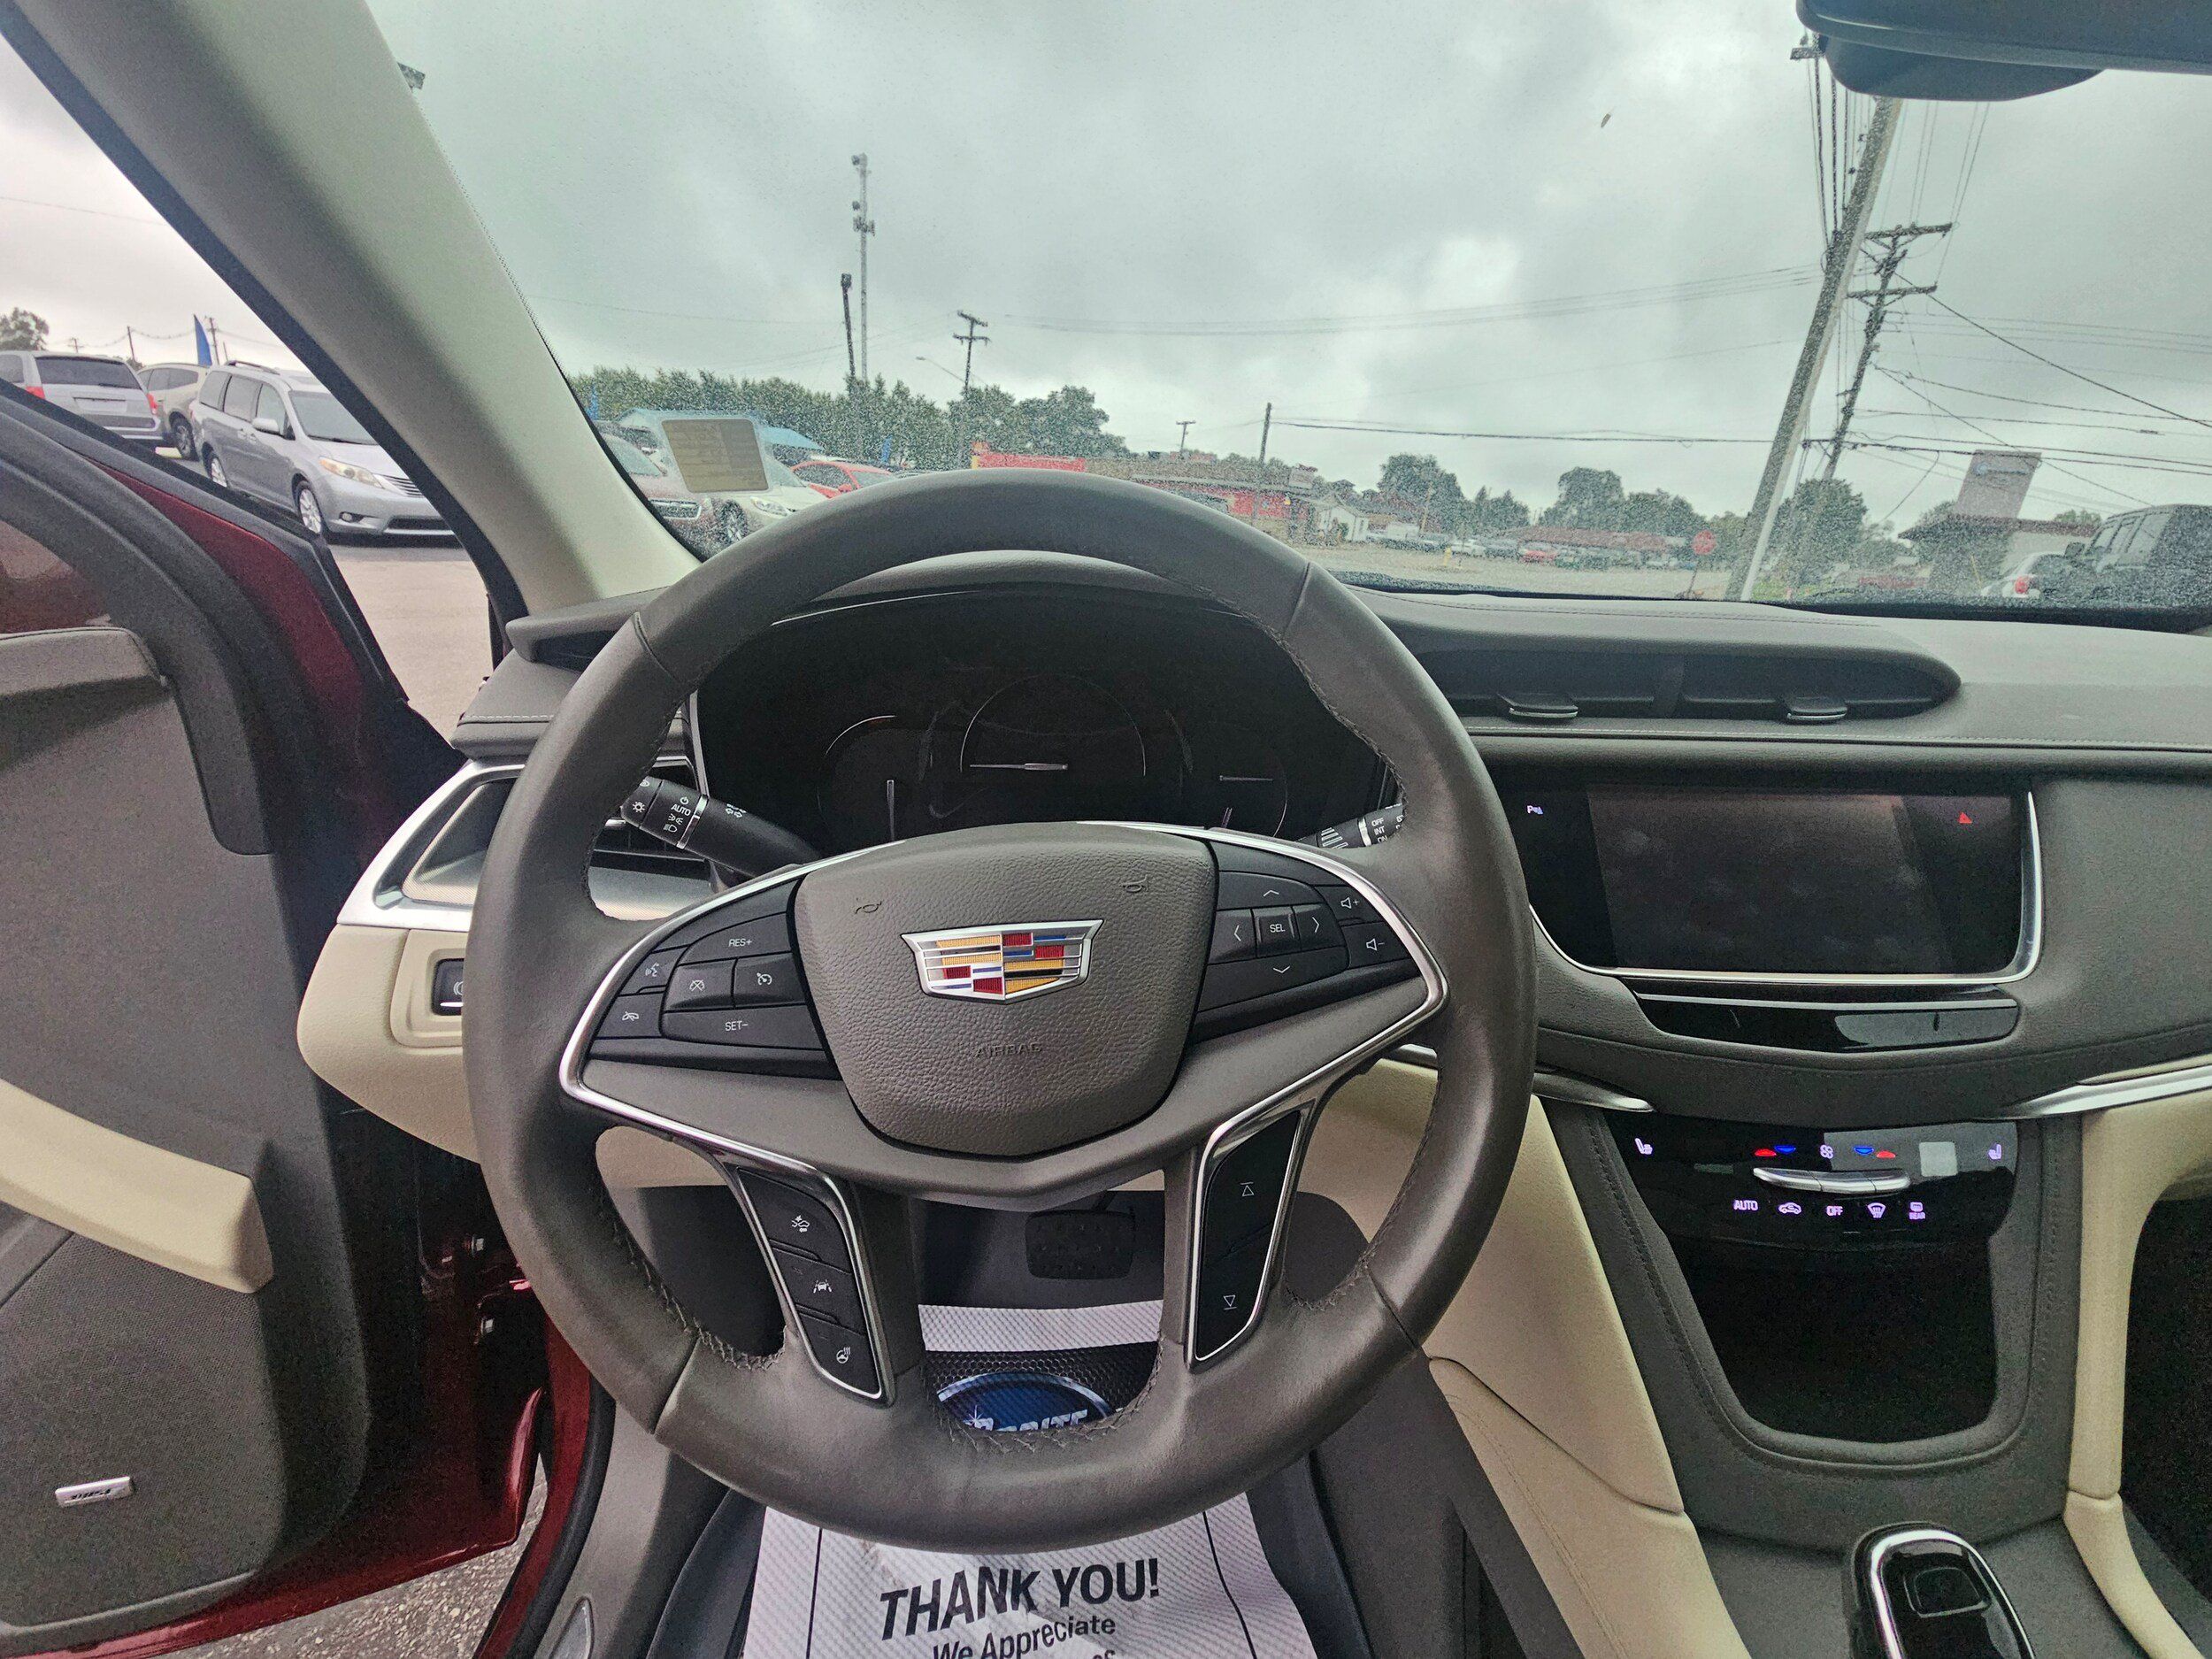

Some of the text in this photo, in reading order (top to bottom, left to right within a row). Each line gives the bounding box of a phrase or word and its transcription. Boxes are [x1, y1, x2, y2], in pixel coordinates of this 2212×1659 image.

[671, 803, 692, 817] AUTO
[1371, 818, 1385, 827] OFF
[1373, 826, 1386, 836] INT
[1269, 923, 1286, 933] SEL
[728, 938, 753, 948] RES+
[725, 1020, 749, 1032] SET-
[974, 1042, 1043, 1058] AIRBAG
[1733, 1199, 1759, 1211] AUTO
[1825, 1205, 1844, 1217] OFF
[879, 1557, 1160, 1641] THANK YOU!
[933, 1615, 1117, 1659] We Appreciate
